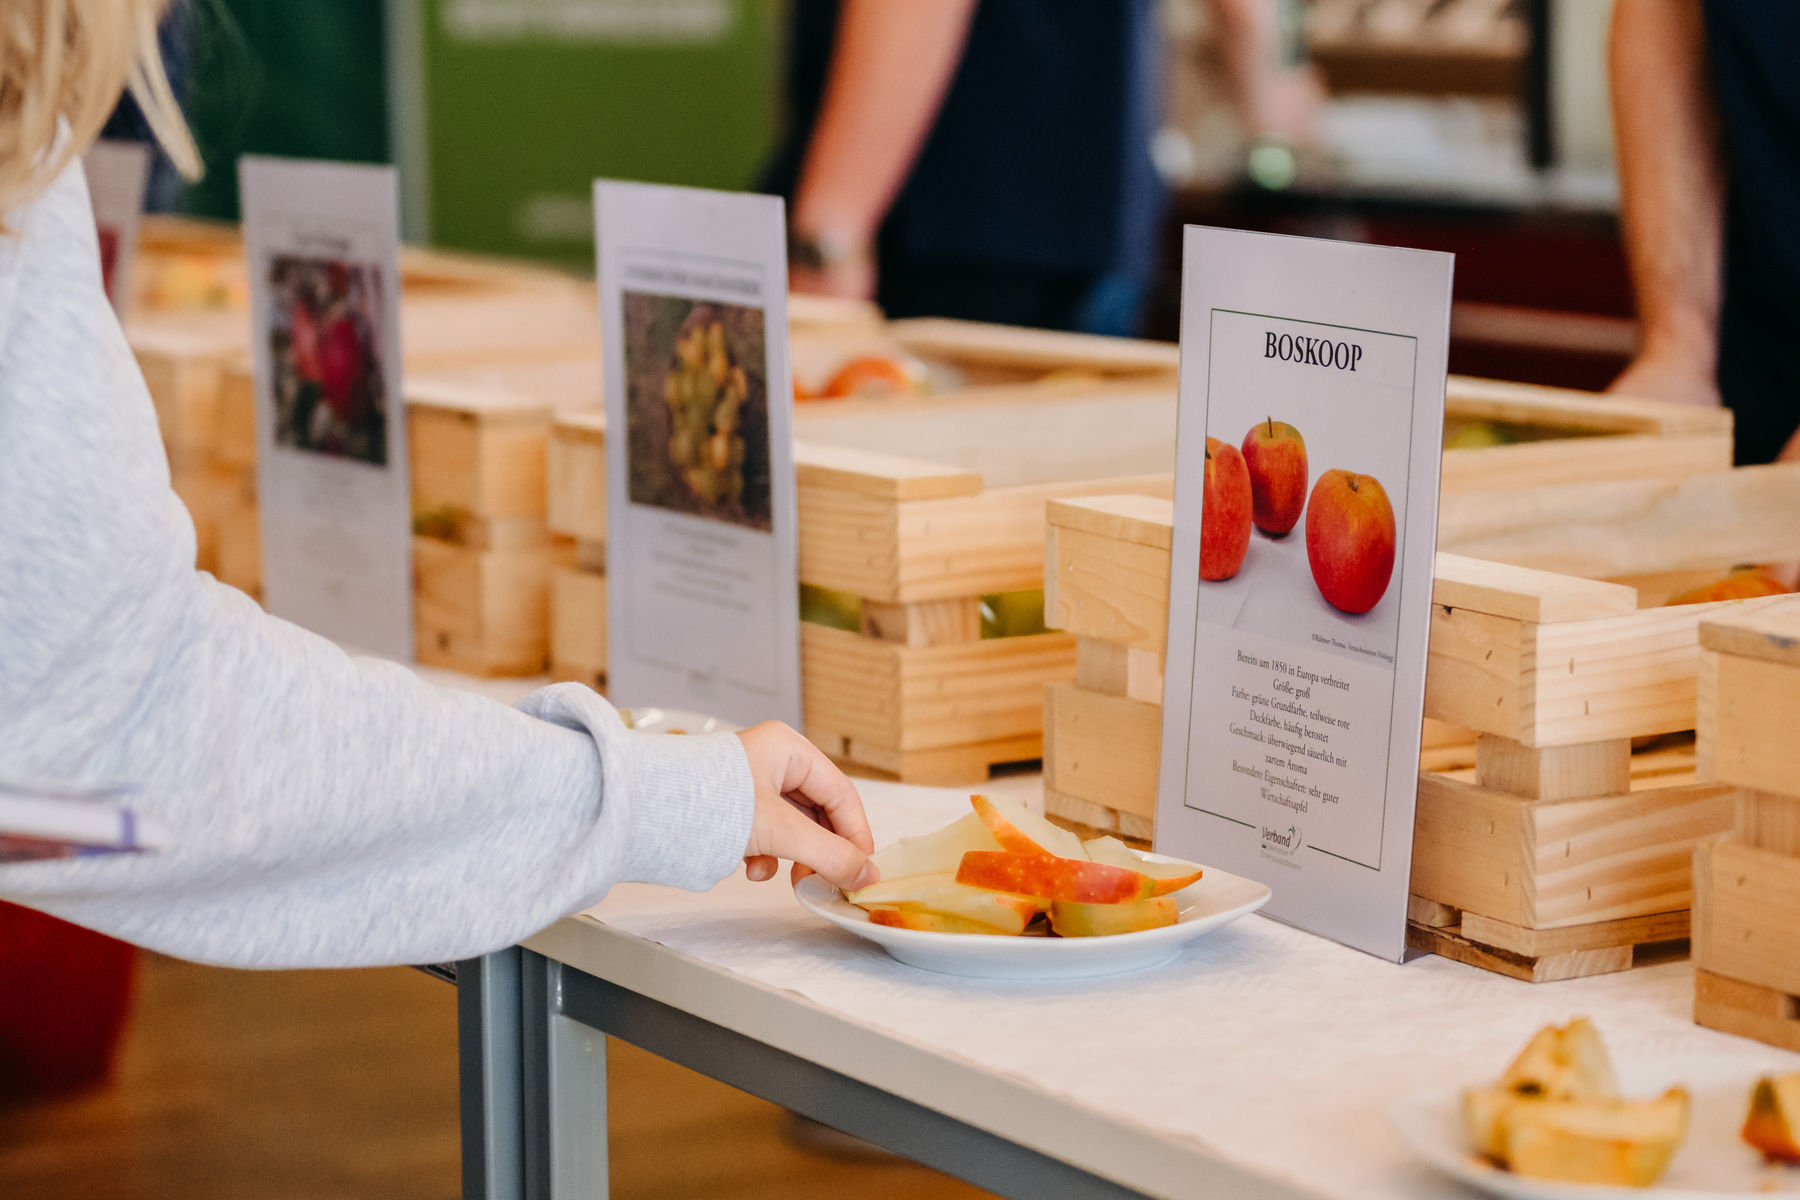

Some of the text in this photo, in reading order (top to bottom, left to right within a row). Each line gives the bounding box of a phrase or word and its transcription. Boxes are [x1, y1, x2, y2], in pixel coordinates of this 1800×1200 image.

[1264, 331, 1362, 372] BOSKOOP
[1237, 650, 1350, 691] Bereits um 1850 in Europa verbreitet
[1273, 679, 1311, 699] Größe: groß
[1231, 685, 1350, 730] Farbe: grüne Grundfarbe, teilweise rote
[1250, 709, 1329, 743] Deckfarbe, häufig berostet
[1229, 722, 1347, 768] Geschmack: überwiegend säuerlich mit
[1232, 759, 1340, 804] Besondere Eigenschaften: sehr guter
[1265, 754, 1308, 775] zartem Aroma
[1260, 787, 1308, 814] Wirtschaftsapfel
[1262, 826, 1292, 848] Verband
